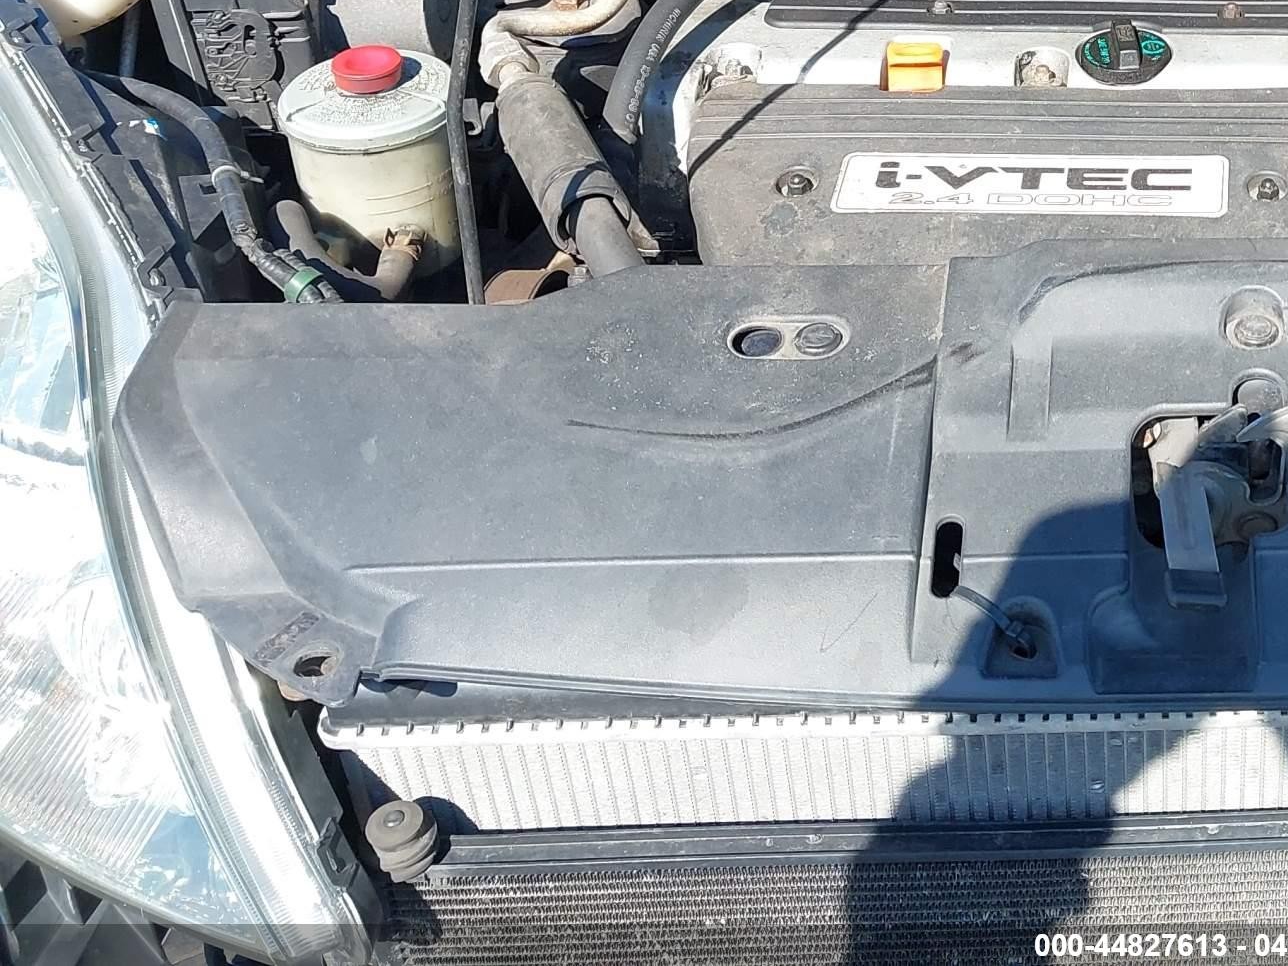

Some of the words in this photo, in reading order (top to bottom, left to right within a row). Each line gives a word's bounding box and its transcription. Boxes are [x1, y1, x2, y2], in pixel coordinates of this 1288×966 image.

[874, 160, 1194, 192] i-VTEC
[887, 191, 975, 206] 2.4
[986, 192, 1173, 207] DOHC
